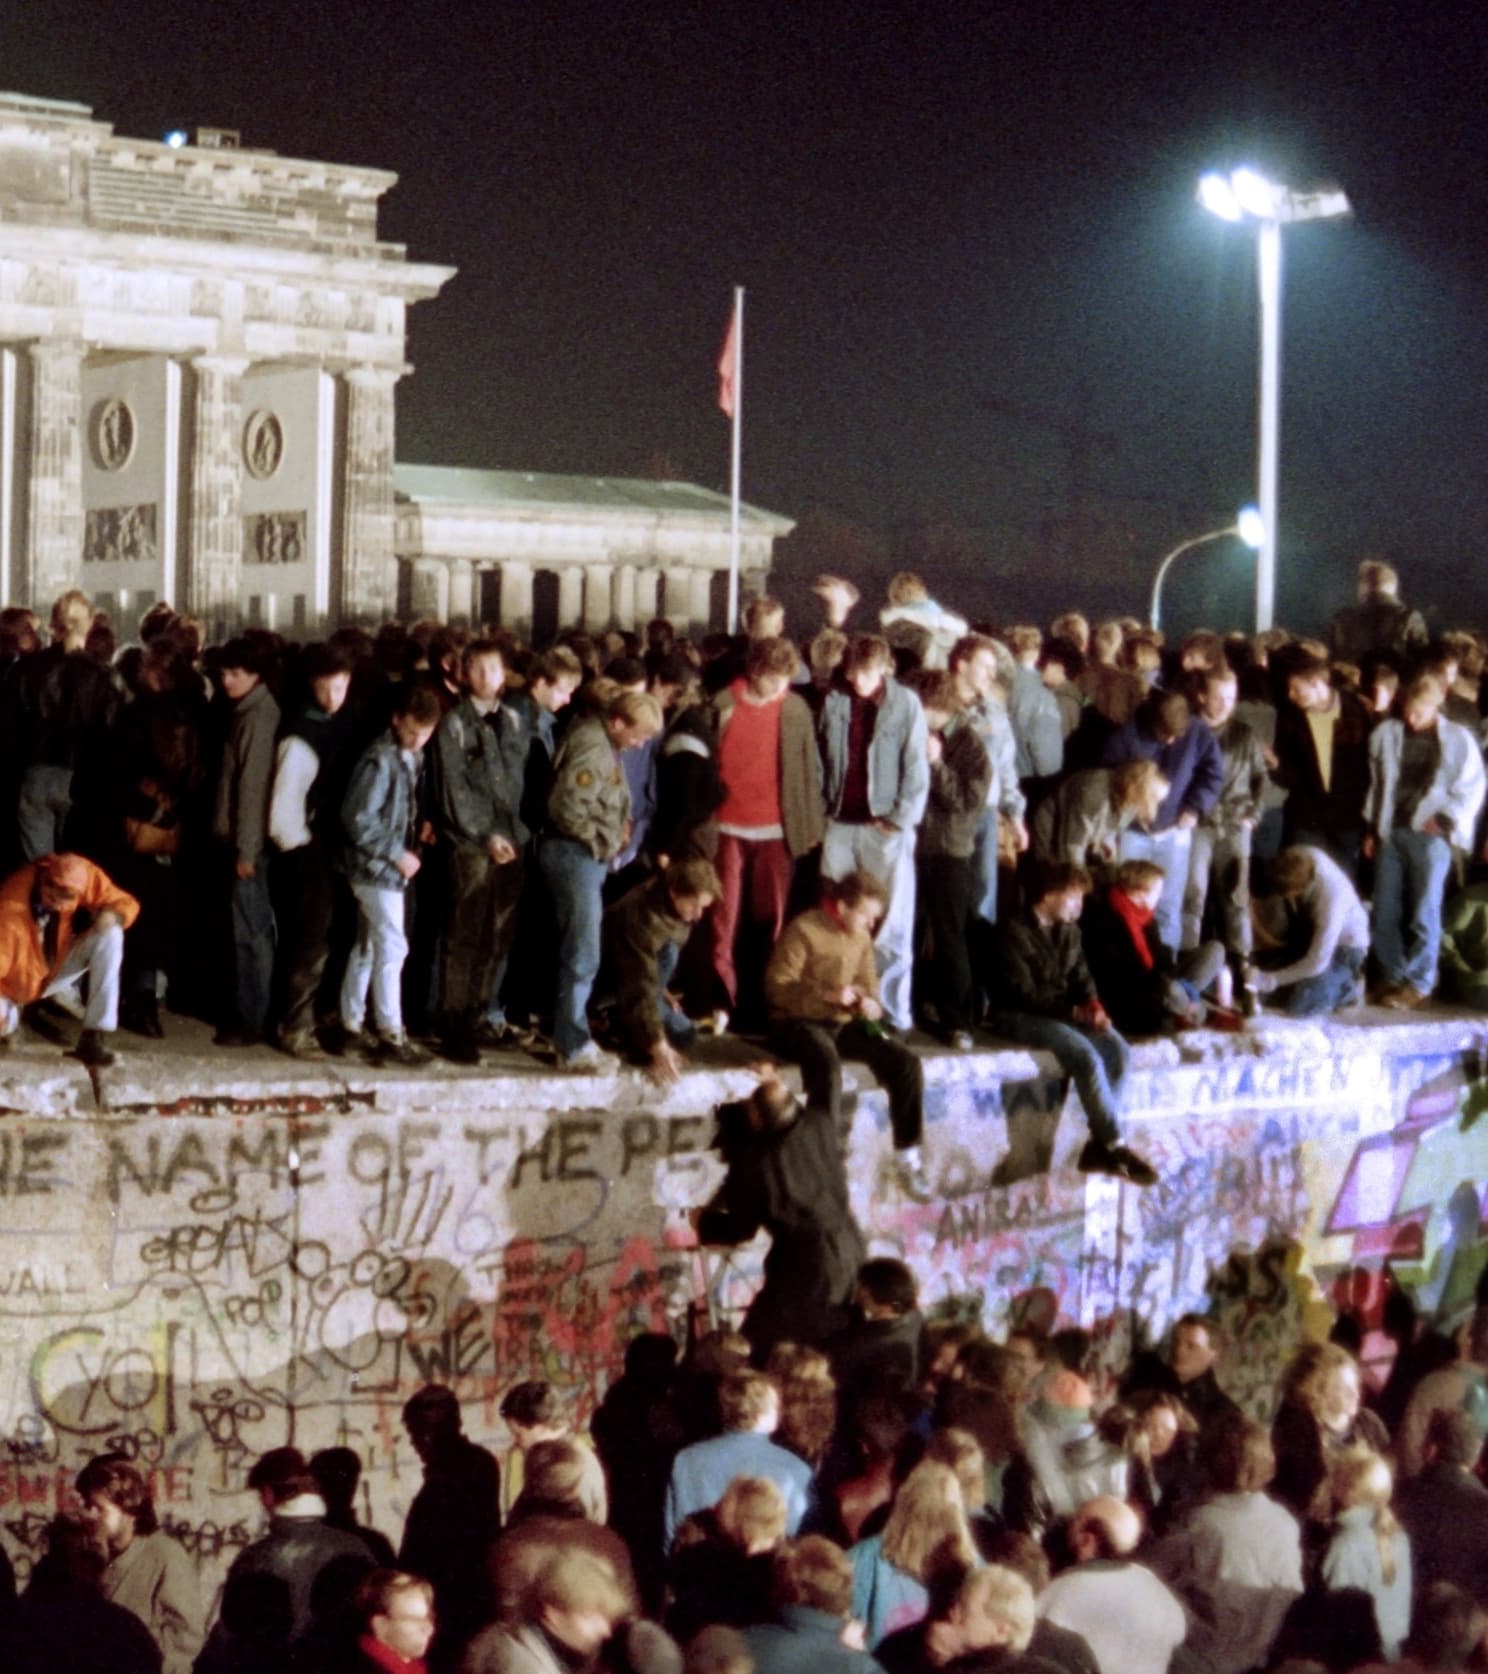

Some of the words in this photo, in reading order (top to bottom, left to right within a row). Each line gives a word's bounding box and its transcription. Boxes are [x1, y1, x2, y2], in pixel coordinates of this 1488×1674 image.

[110, 1121, 331, 1202] NAME
[348, 1122, 443, 1186] OF
[465, 1118, 605, 1188] THE
